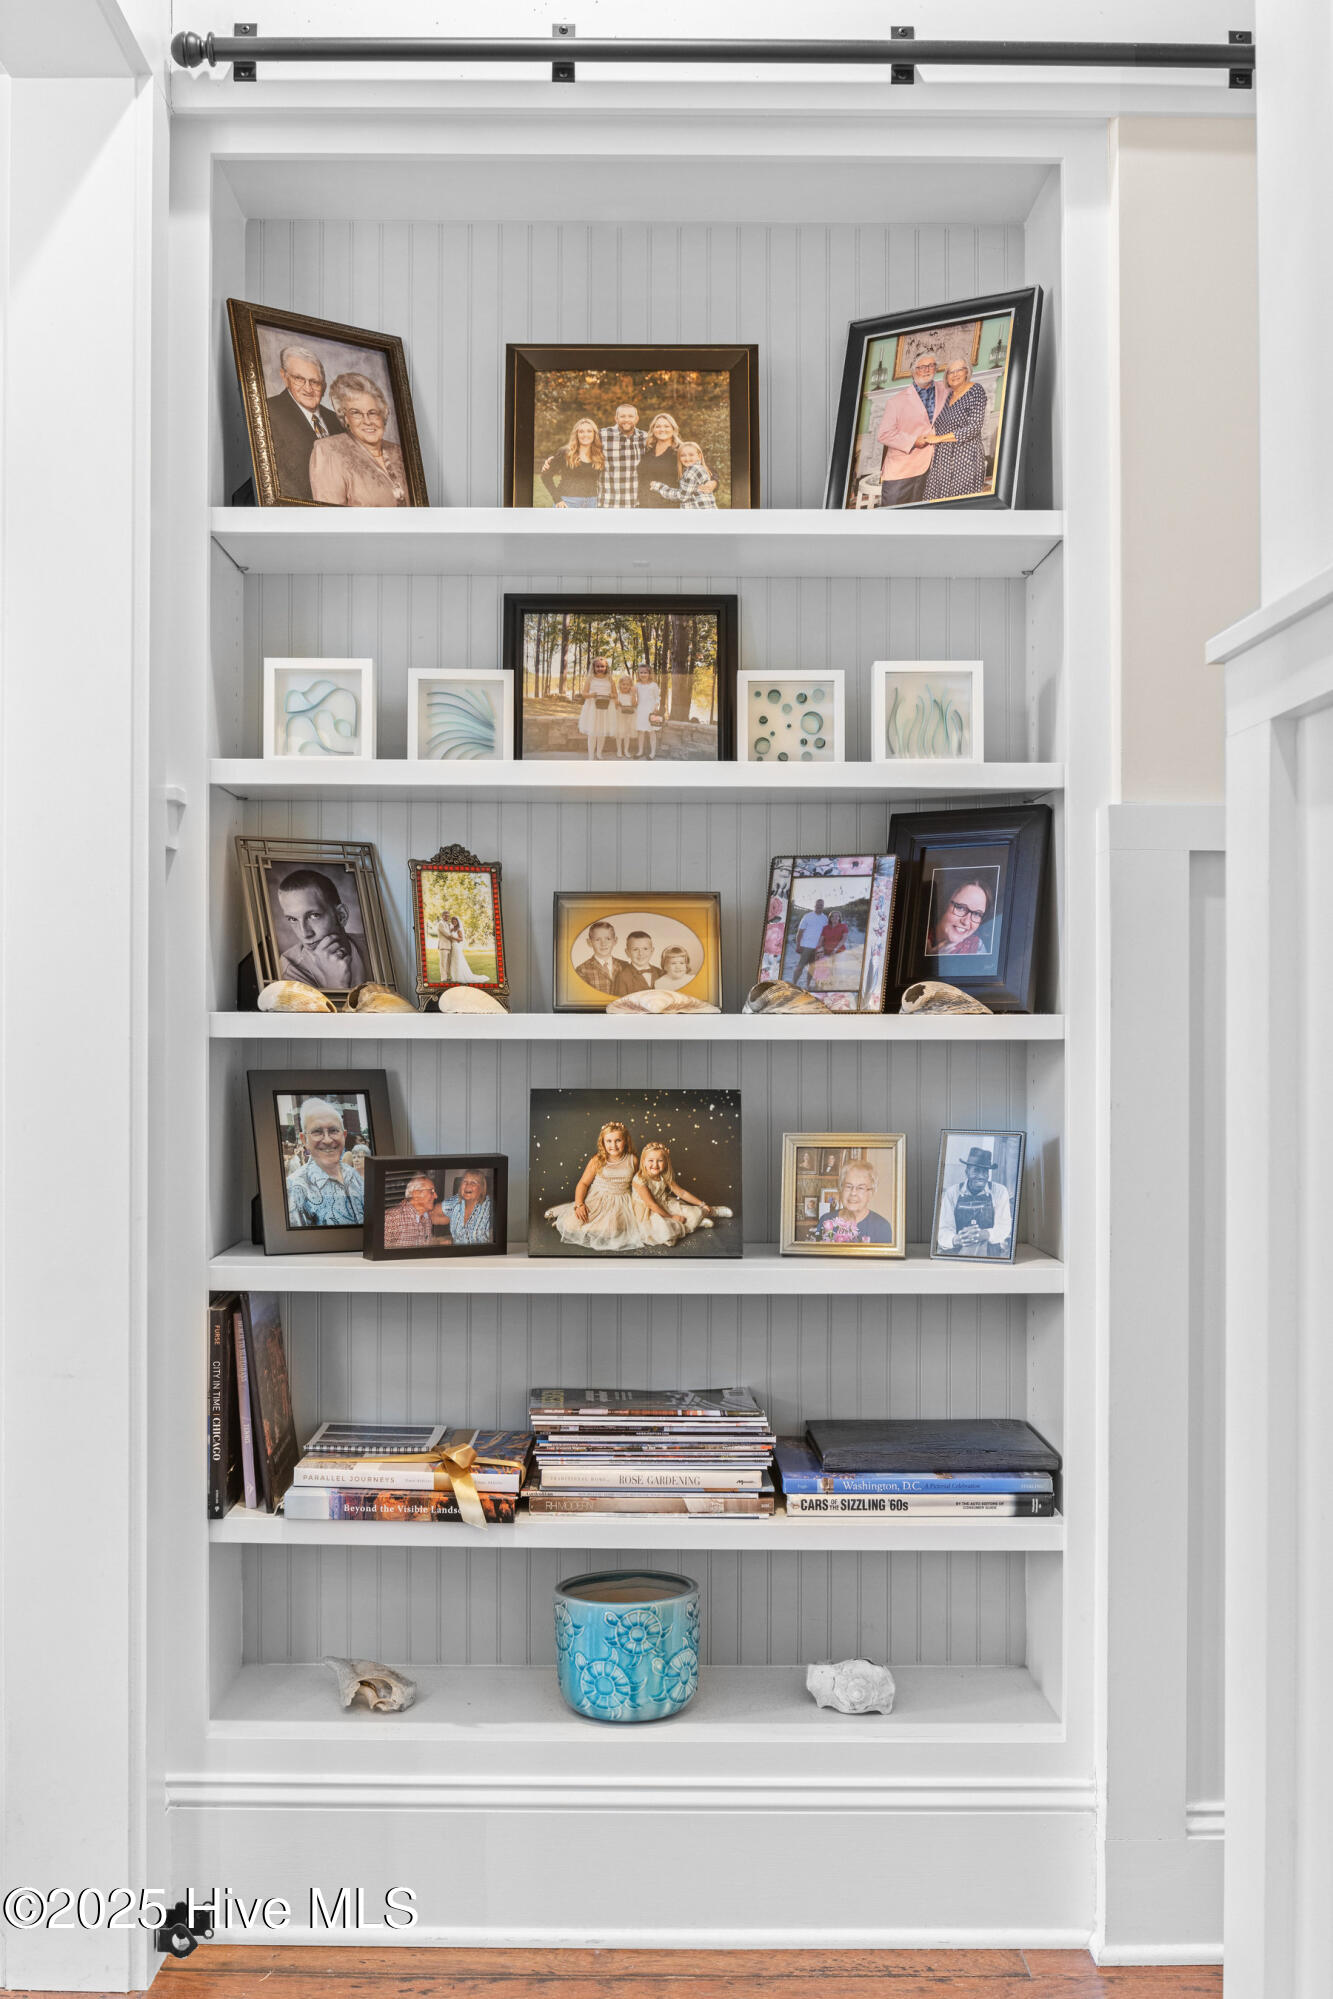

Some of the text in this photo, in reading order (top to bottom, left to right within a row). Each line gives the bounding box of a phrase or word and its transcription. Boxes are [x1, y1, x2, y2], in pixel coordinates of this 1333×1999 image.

[212, 1324, 221, 1461] FURSE CITY IN TIME CHICAGO
[302, 1474, 345, 1482] PARALLEL
[349, 1475, 395, 1484] JOURNEYS
[619, 1474, 701, 1486] ROSE GARDENING
[842, 1481, 922, 1491] Washington, D.C.
[343, 1504, 377, 1514] Beyond
[379, 1504, 395, 1513] the
[396, 1504, 429, 1514] Visible
[800, 1499, 829, 1511] CARS
[840, 1499, 886, 1511] SIZZLING
